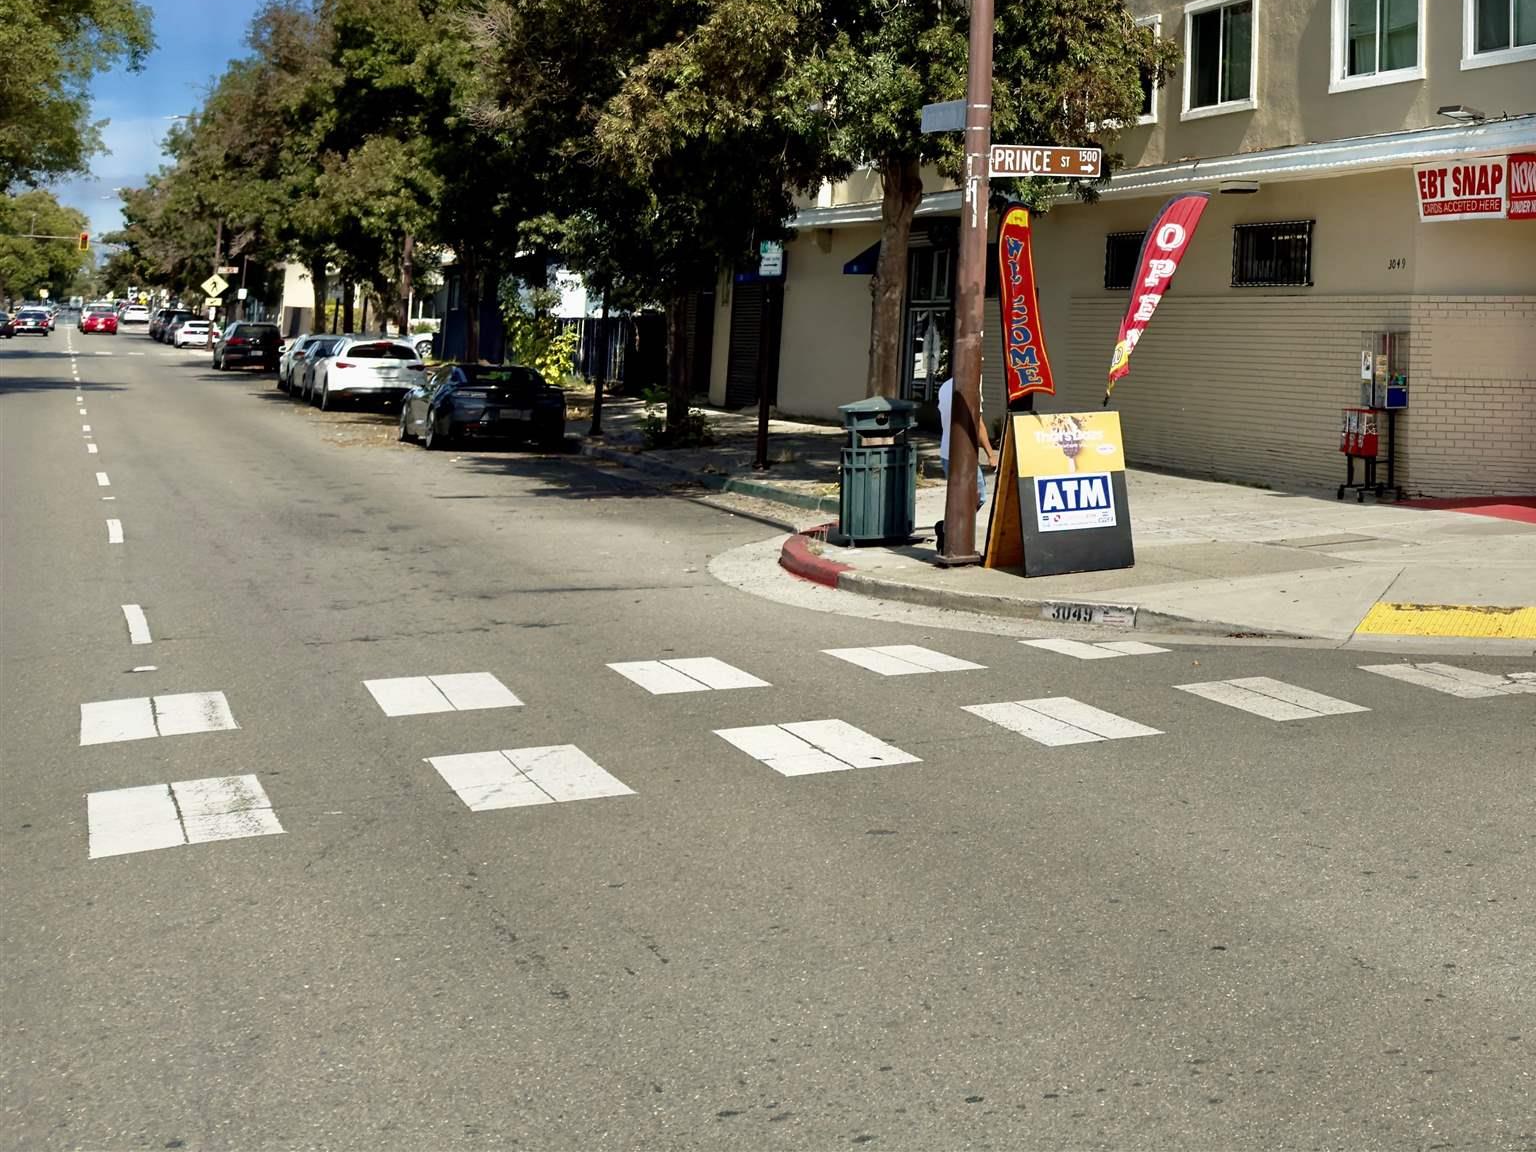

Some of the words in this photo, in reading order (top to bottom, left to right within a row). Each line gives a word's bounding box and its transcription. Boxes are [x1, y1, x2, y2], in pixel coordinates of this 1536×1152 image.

[994, 149, 1052, 172] PRINCE
[1061, 156, 1071, 168] ST
[1417, 170, 1447, 199] EBT
[1452, 164, 1503, 196] SNAP
[1424, 204, 1443, 214] CARDS
[1444, 201, 1477, 213] ACCETED
[1479, 199, 1500, 211] HERE
[1510, 200, 1531, 214] UNDER
[1388, 258, 1407, 270] 3049
[1043, 478, 1107, 511] ATM
[1052, 606, 1093, 622] 3049
